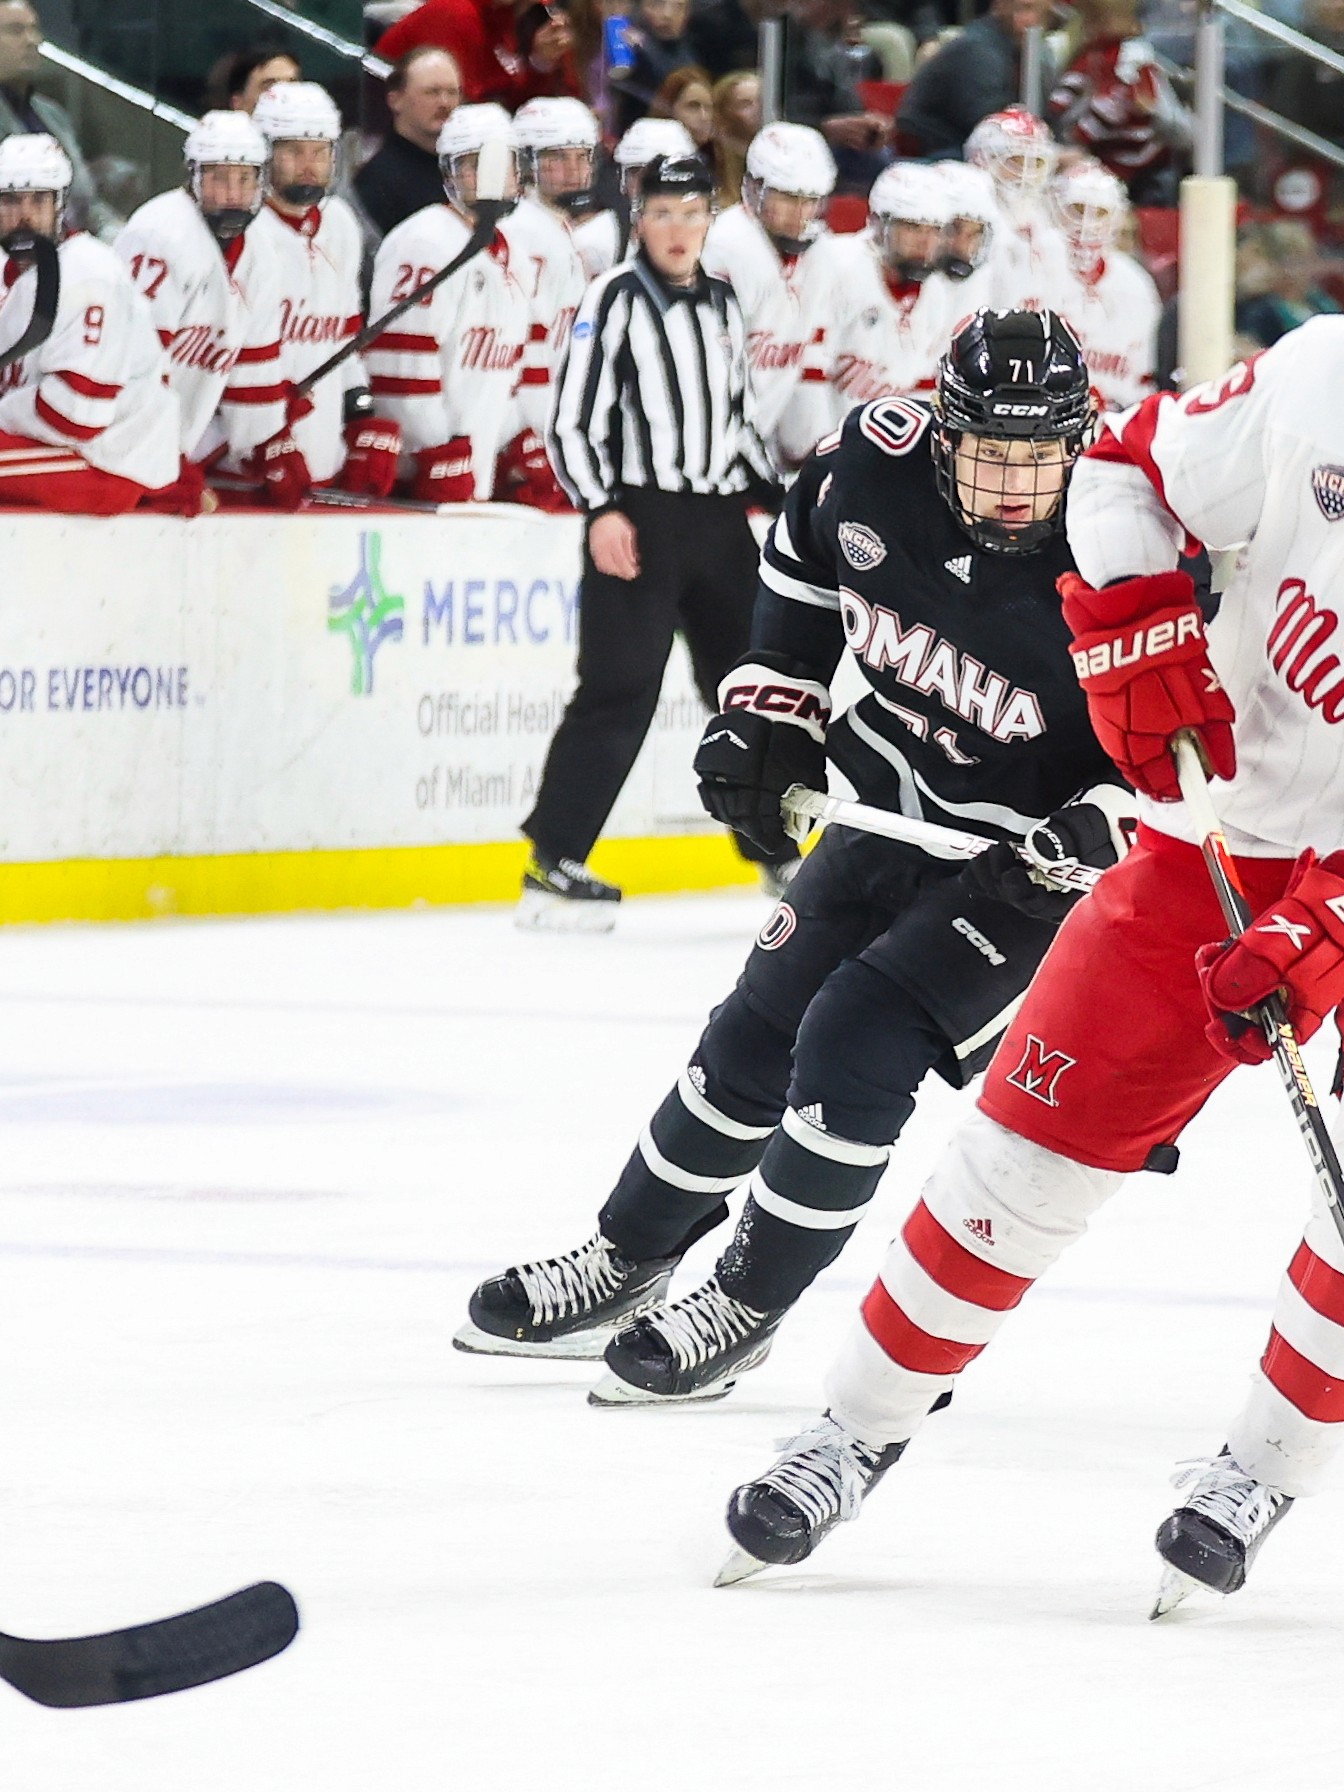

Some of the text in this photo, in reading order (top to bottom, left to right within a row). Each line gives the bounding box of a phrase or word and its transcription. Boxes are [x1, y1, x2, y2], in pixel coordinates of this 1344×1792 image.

[130, 254, 168, 299] 17
[83, 305, 105, 346] 9
[1008, 358, 1034, 384] 71
[992, 403, 1049, 417] CCM
[423, 579, 582, 645] MERCY
[839, 585, 1048, 743] OMAHA
[417, 690, 499, 737] Official
[723, 685, 832, 732] CCM
[416, 765, 439, 810] of
[446, 763, 512, 808] Miami
[951, 917, 1007, 967] CCM
[1006, 1034, 1077, 1107] M
[963, 1218, 995, 1246] adidas
